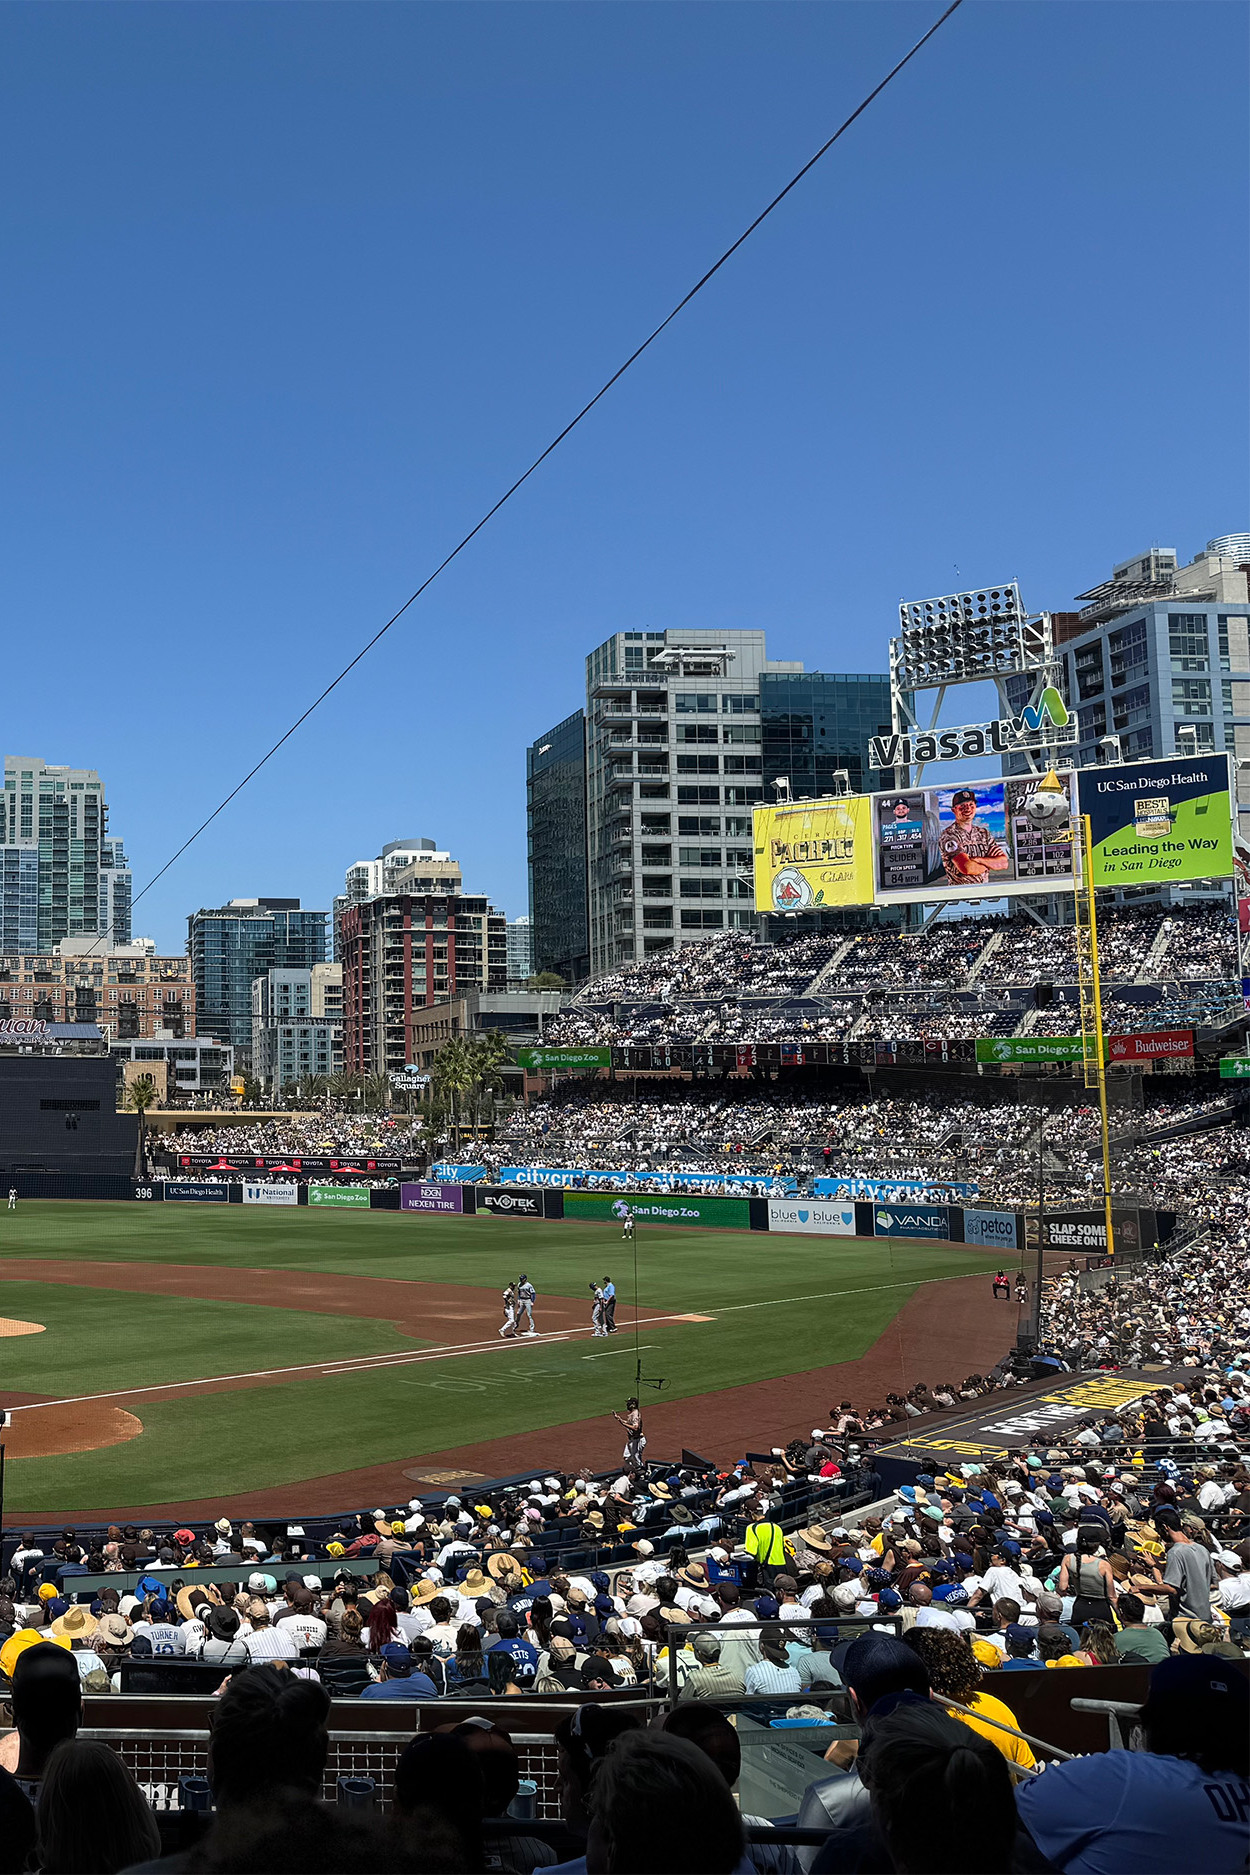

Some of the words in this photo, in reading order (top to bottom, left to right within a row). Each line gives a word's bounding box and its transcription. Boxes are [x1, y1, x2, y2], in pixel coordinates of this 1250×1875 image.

[872, 720, 1009, 767] Viasat
[1097, 781, 1115, 793] UC
[1116, 780, 1137, 791] San
[1138, 777, 1170, 789] Diego
[1171, 772, 1208, 785] Health
[1136, 799, 1167, 810] BEST
[1103, 843, 1159, 857] Leading
[1162, 841, 1185, 853] the
[1188, 838, 1219, 851] Way
[890, 852, 917, 863] SLIDER
[1104, 862, 1116, 872] in
[1120, 860, 1143, 871] San
[1148, 858, 1182, 870] Diego
[891, 874, 904, 883] 84
[1015, 1045, 1038, 1054] San
[1040, 1044, 1069, 1056] Diego
[1135, 1038, 1188, 1053] Budweiser
[544, 1053, 559, 1062] San
[560, 1053, 582, 1064] Diego
[583, 1053, 599, 1062] Zoo
[389, 1074, 431, 1083] Gallagher
[395, 1082, 425, 1090] Square
[435, 1165, 458, 1177] city
[135, 1188, 152, 1199] 396
[189, 1187, 204, 1197] Diego
[205, 1188, 223, 1196] Health
[262, 1188, 294, 1197] National
[337, 1193, 353, 1202] Diego
[354, 1194, 368, 1202] Zoo
[409, 1200, 435, 1208] NEXEN
[437, 1201, 455, 1209] TIRE
[485, 1194, 535, 1209] EVOTEK
[632, 1205, 649, 1215] San
[650, 1205, 678, 1218] Diego
[679, 1206, 700, 1217] Zoo
[771, 1208, 797, 1220] blue
[813, 1210, 840, 1222] blue
[894, 1214, 948, 1226] VANDA
[981, 1217, 1013, 1235] petco
[1050, 1223, 1077, 1235] SLAP
[1078, 1224, 1107, 1236] SOME
[1050, 1234, 1083, 1245] CHEESE
[1084, 1235, 1098, 1246] ON
[296, 1625, 319, 1633] LANDERS
[150, 1630, 178, 1641] TURNER
